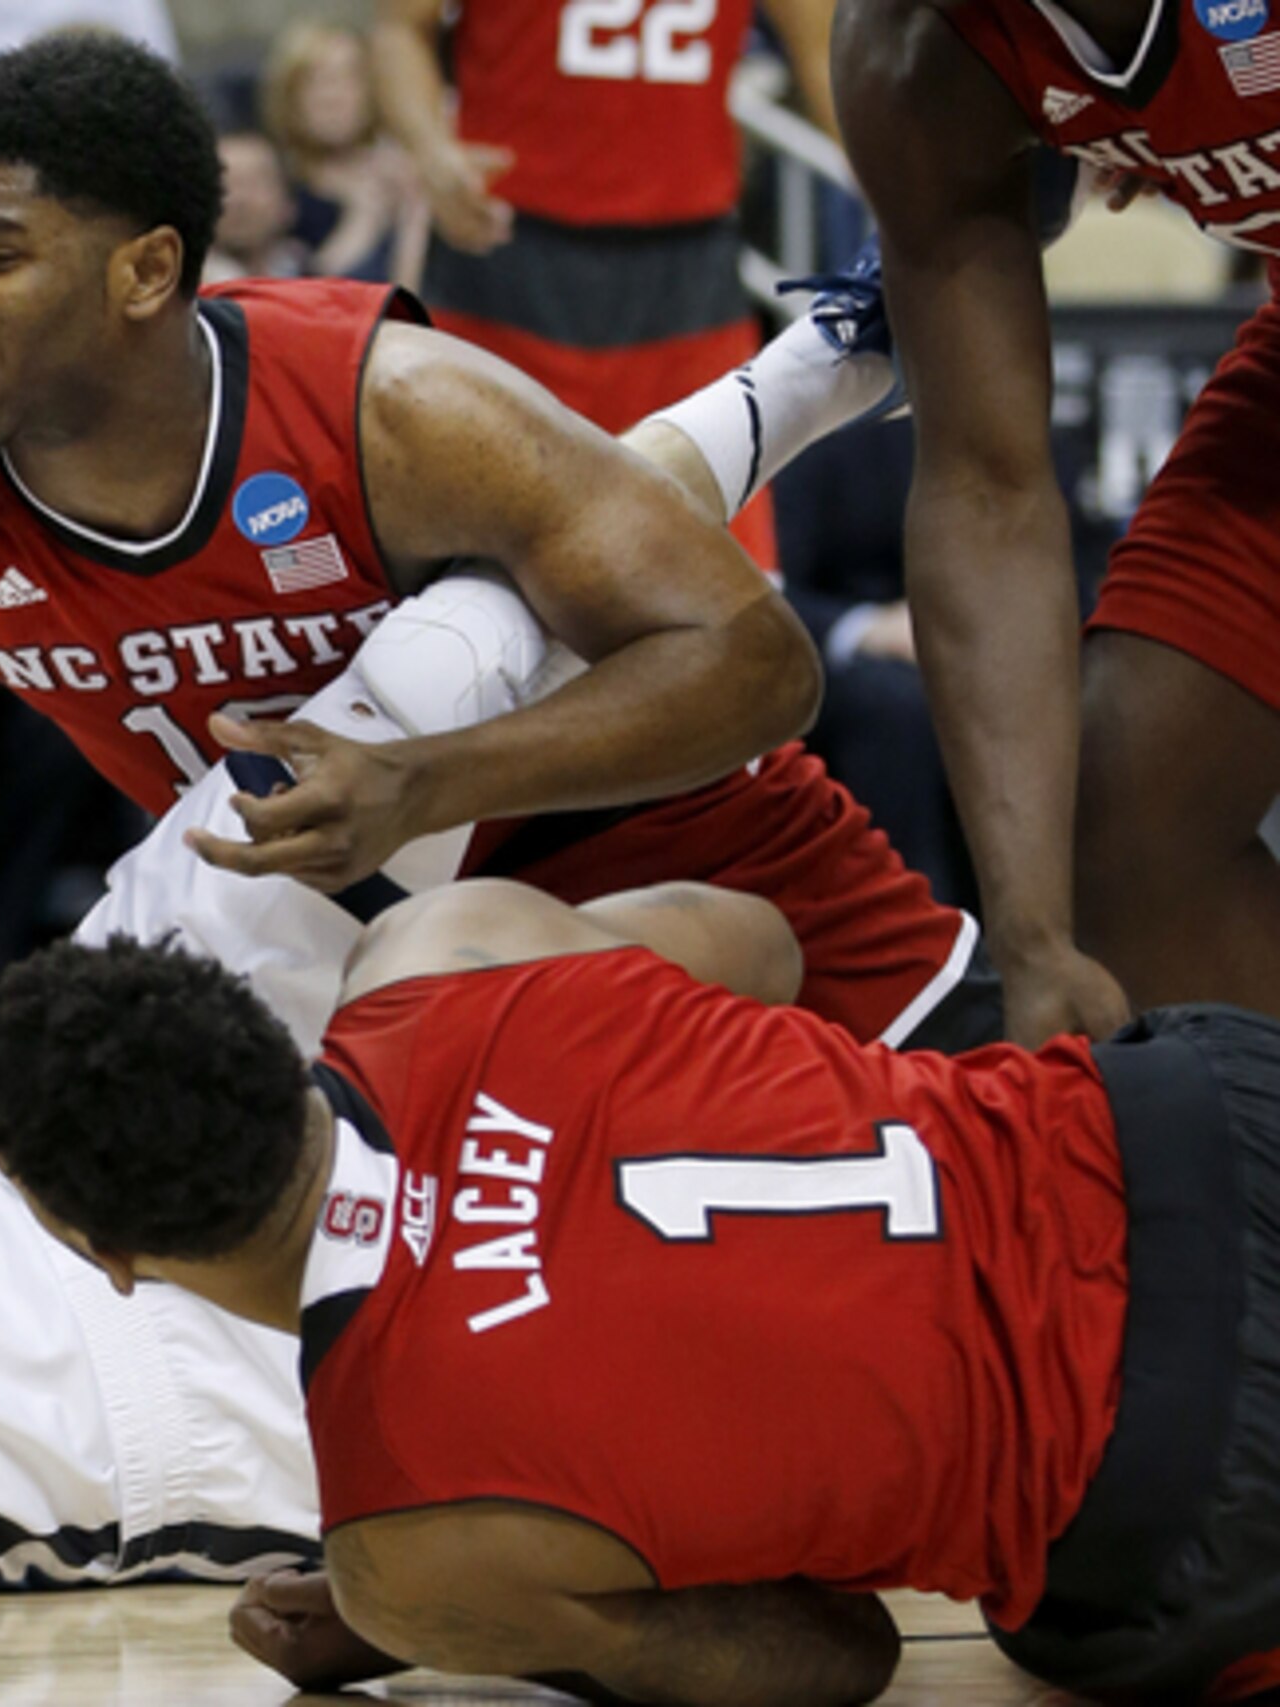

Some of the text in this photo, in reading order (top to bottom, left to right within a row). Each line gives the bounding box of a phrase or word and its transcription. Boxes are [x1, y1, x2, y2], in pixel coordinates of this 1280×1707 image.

[557, 0, 718, 84] 22
[247, 496, 307, 535] NCAA
[401, 1168, 439, 1268] ACC
[451, 1091, 554, 1334] LACEY
[615, 1119, 943, 1244] 1
